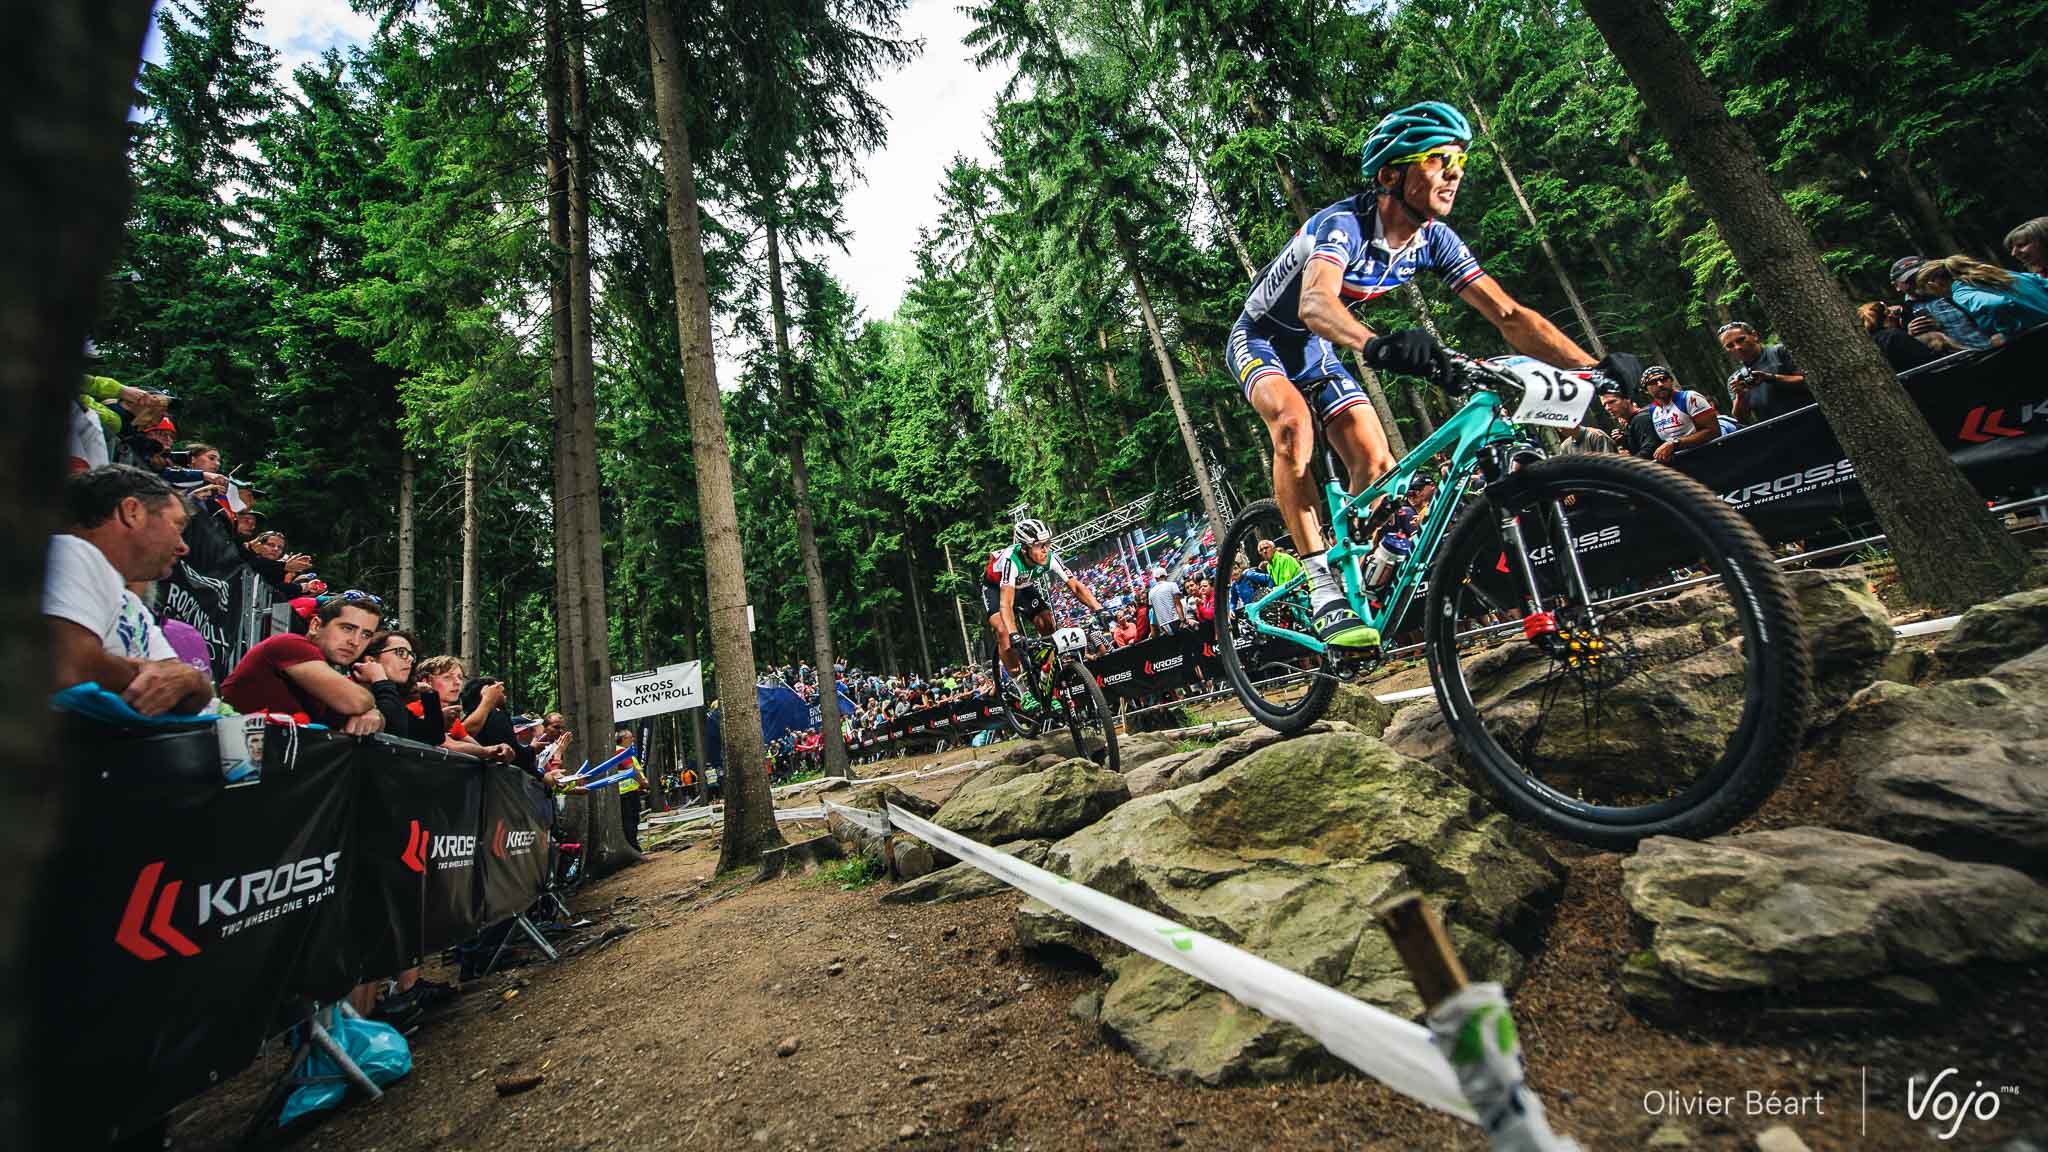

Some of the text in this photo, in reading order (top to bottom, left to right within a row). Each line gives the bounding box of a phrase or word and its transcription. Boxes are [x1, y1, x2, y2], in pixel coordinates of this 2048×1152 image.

[1267, 248, 1298, 297] FRANCE
[1531, 369, 1579, 403] 16
[1754, 491, 1793, 505] WHEELS
[1796, 484, 1817, 494] ONE
[1062, 631, 1080, 647] 14
[1152, 655, 1184, 671] KROSS
[635, 680, 674, 695] KROSS
[1103, 671, 1132, 684] KROSS
[616, 686, 694, 709] ROCK'N'ROLL
[431, 835, 477, 859] KROS
[198, 851, 342, 926] KROSS
[221, 898, 303, 938] TWO WHEELS ONE
